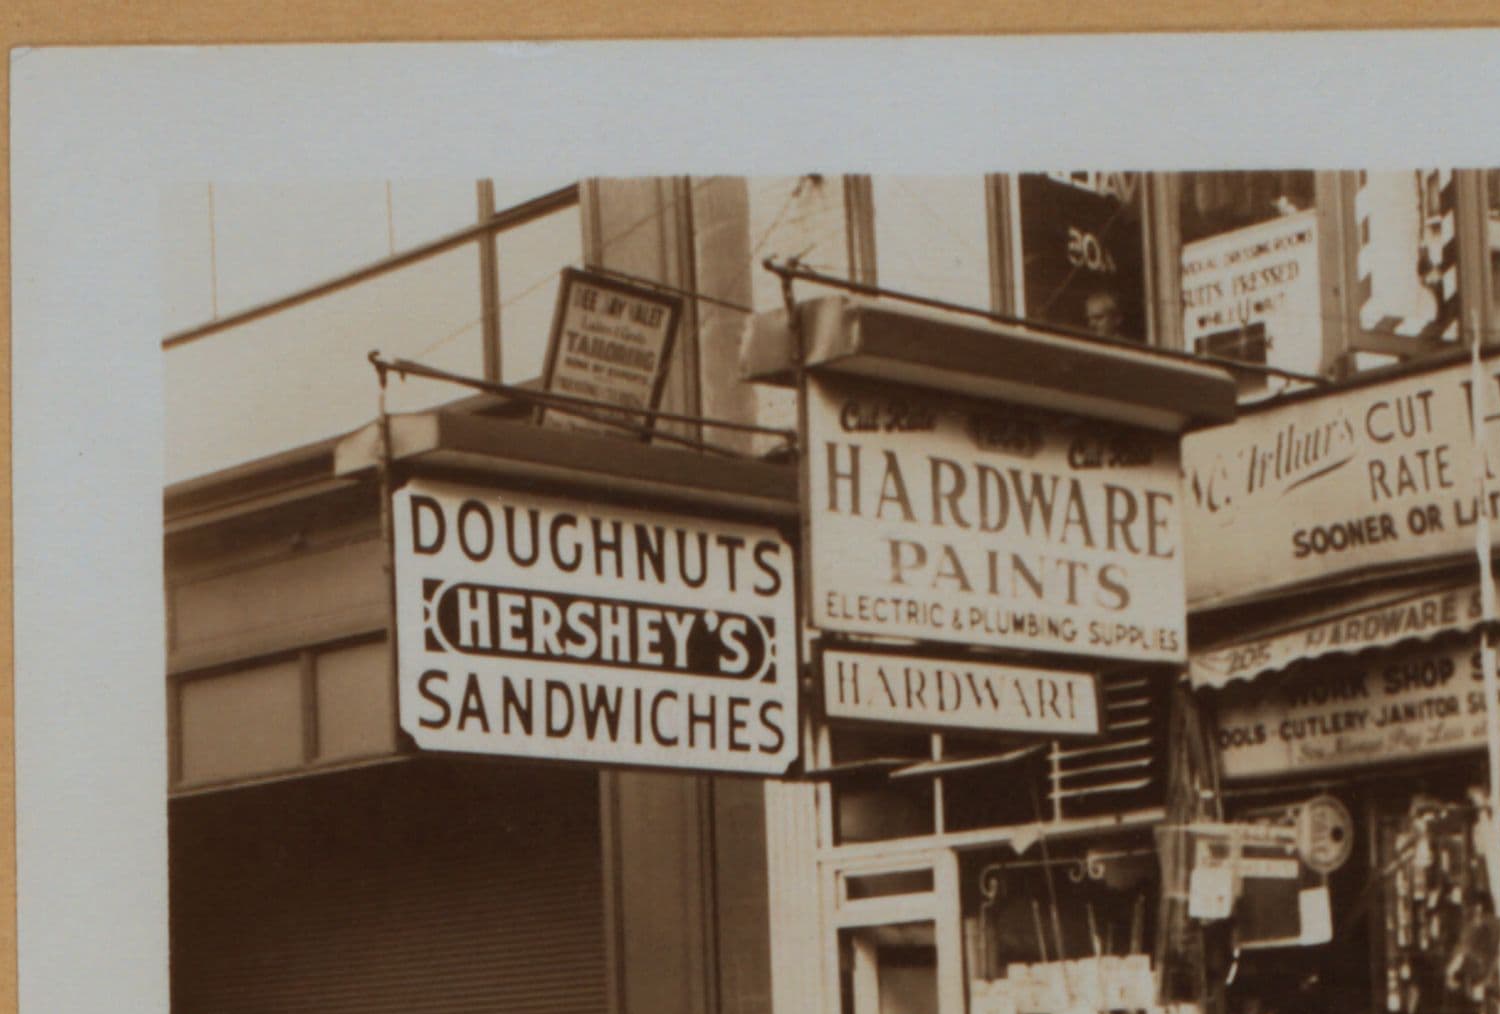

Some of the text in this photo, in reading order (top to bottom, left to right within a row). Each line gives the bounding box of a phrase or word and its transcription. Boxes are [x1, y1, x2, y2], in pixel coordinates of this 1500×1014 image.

[1365, 390, 1435, 443] CUT
[825, 441, 1176, 561] HARDWARE
[1368, 445, 1454, 502] RATE
[409, 493, 783, 598] DOUGHNUTS
[1292, 513, 1398, 560] SOONER
[1408, 506, 1443, 537] OR
[888, 538, 1131, 612] PAINTS
[457, 585, 750, 675] HERSHEY'S
[826, 591, 944, 629] ELECTRIC
[969, 606, 1078, 643] PLUMBING
[1090, 621, 1179, 653] SUPPLIES
[1382, 658, 1455, 696] SHOP
[416, 668, 786, 755] SANDWICHES
[1279, 708, 1370, 742] CUTLERY
[1374, 694, 1459, 728] JANITOR
